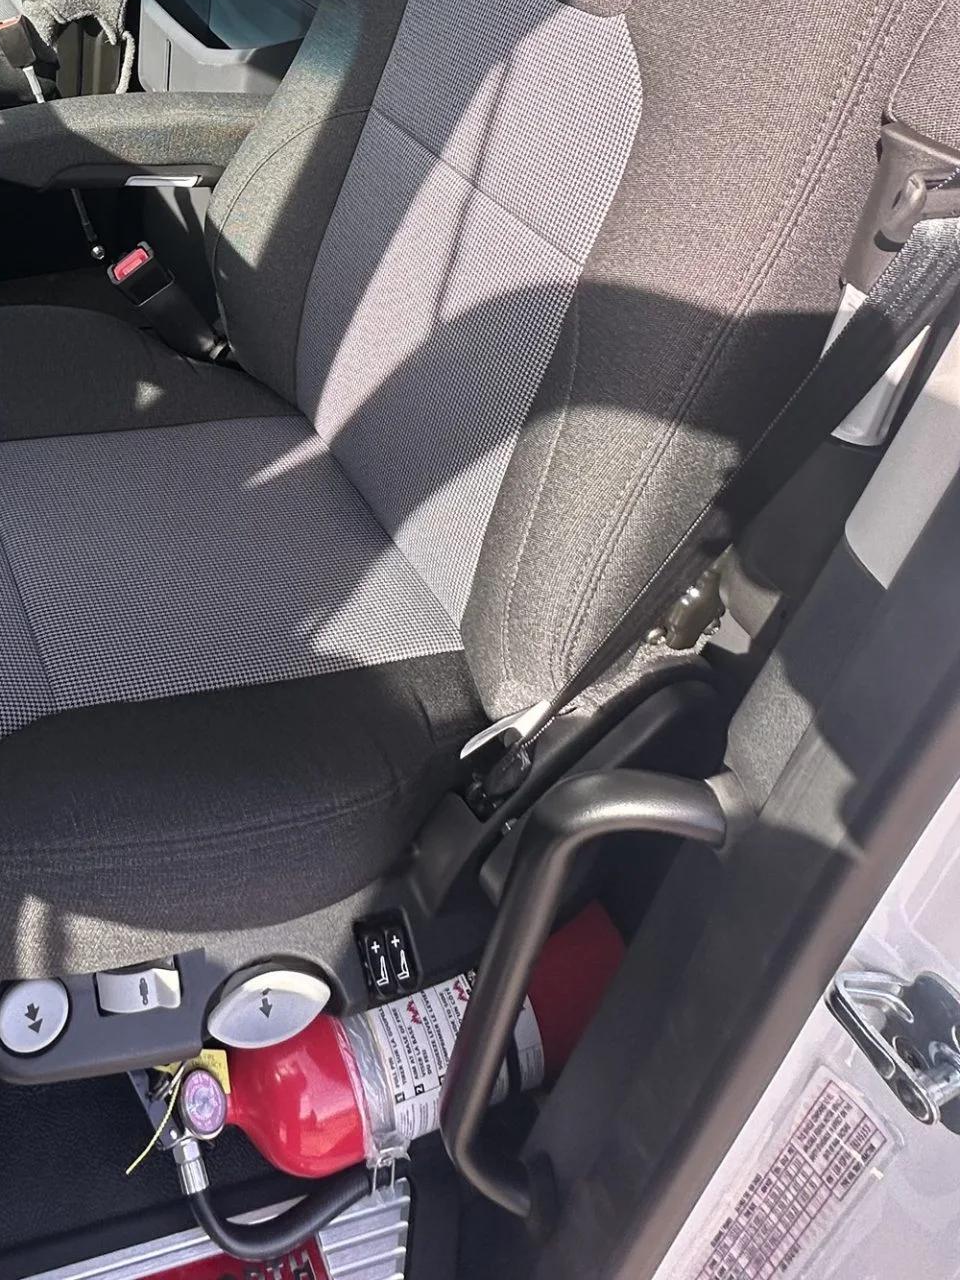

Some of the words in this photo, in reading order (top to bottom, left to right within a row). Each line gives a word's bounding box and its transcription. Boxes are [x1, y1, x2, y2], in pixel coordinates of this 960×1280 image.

[439, 991, 448, 1008] SIDE
[392, 1007, 400, 1022] FIRE
[429, 1012, 436, 1022] LE
[446, 1008, 453, 1018] TO
[377, 1007, 393, 1036] GOUPILL
[398, 1024, 405, 1033] OF
[422, 1015, 434, 1038] LEVER
[407, 1025, 417, 1044] BASE
[390, 1038, 397, 1048] LA
[402, 1035, 412, 1053] BASE
[414, 1045, 420, 1055] LA
[393, 1048, 401, 1063] SUR
[408, 1055, 415, 1063] AT
[430, 1038, 442, 1070] SQUEEZE
[398, 1064, 407, 1084] TIRER
[425, 1063, 432, 1074] DU
